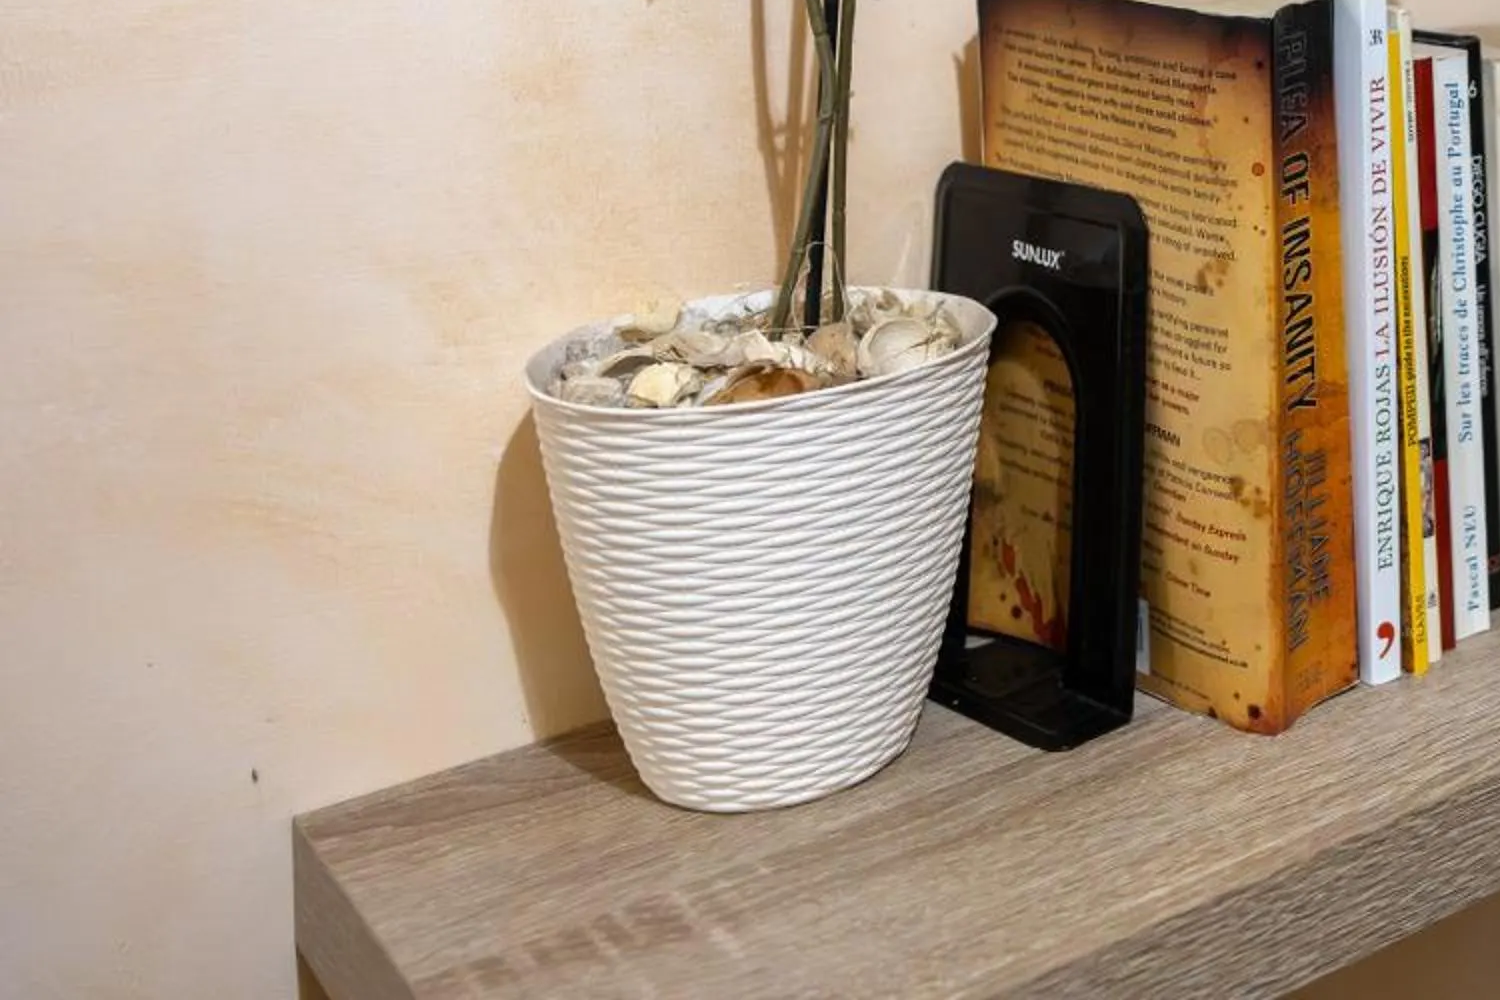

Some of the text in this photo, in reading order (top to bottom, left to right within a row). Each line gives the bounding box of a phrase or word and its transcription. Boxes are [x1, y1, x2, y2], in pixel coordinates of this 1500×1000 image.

[1281, 150, 1311, 206] OF
[1371, 77, 1389, 357] LA ILUSIÓN DE VIVIR
[1011, 239, 1062, 270] SUNLUX
[1283, 217, 1317, 414] INSANITY
[1444, 82, 1473, 444] Sur les traces de Christophe au Portugal
[1376, 364, 1394, 571] ENRIQUE ROJAS
[1407, 385, 1418, 448] POMPEII
[1465, 504, 1481, 612] Pascal NEU
